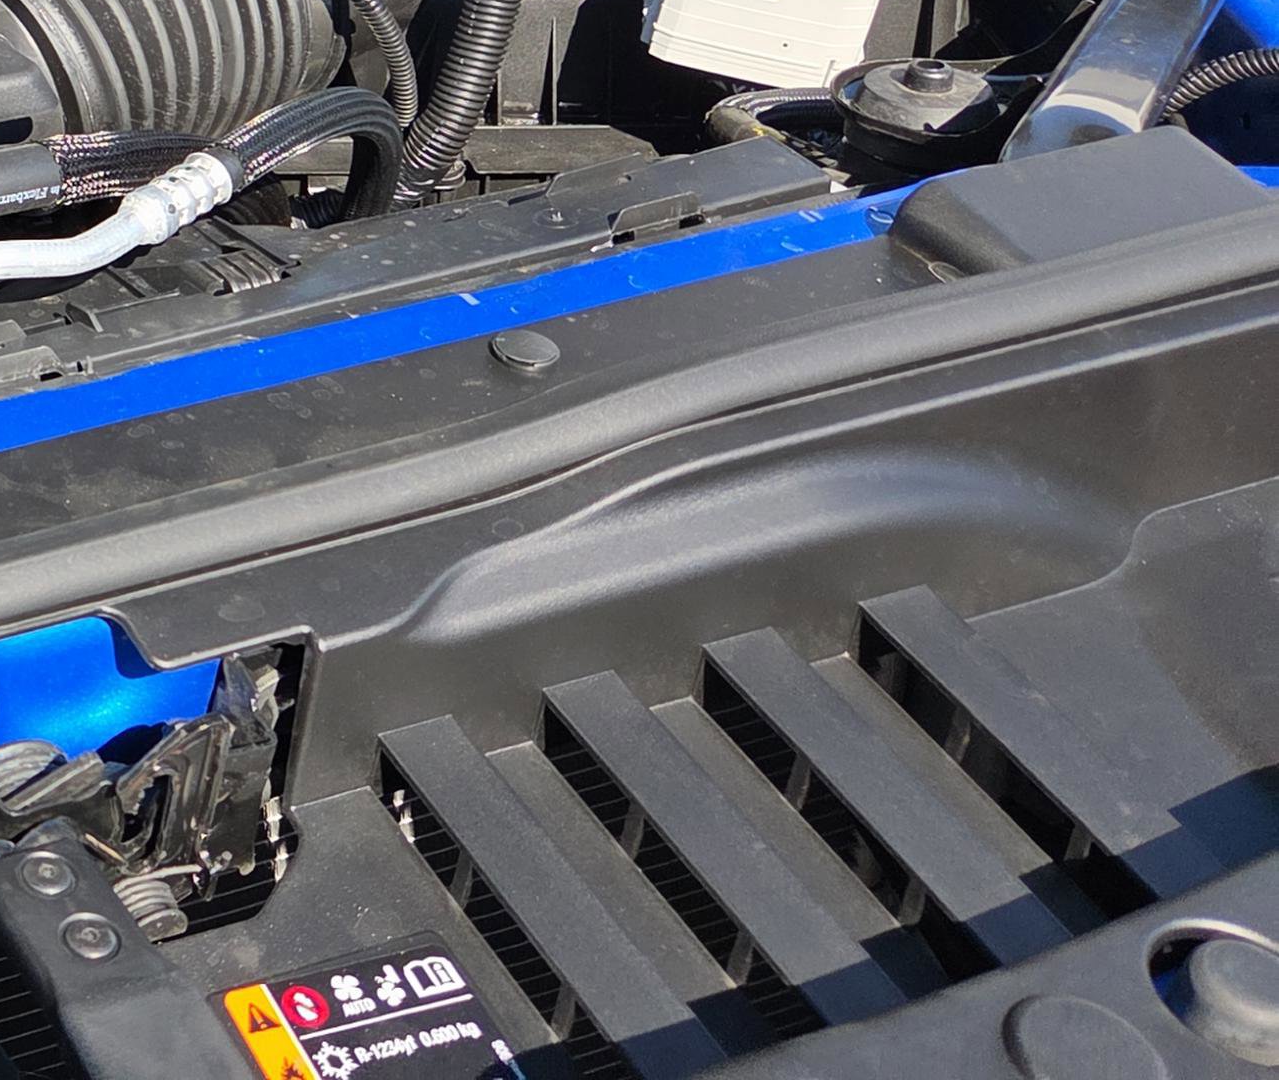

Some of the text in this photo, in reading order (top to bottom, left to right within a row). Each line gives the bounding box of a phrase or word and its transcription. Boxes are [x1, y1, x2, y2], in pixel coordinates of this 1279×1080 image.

[342, 997, 377, 1018] AUTO
[353, 1035, 419, 1064] R-1234yf
[459, 1021, 483, 1040] kg
